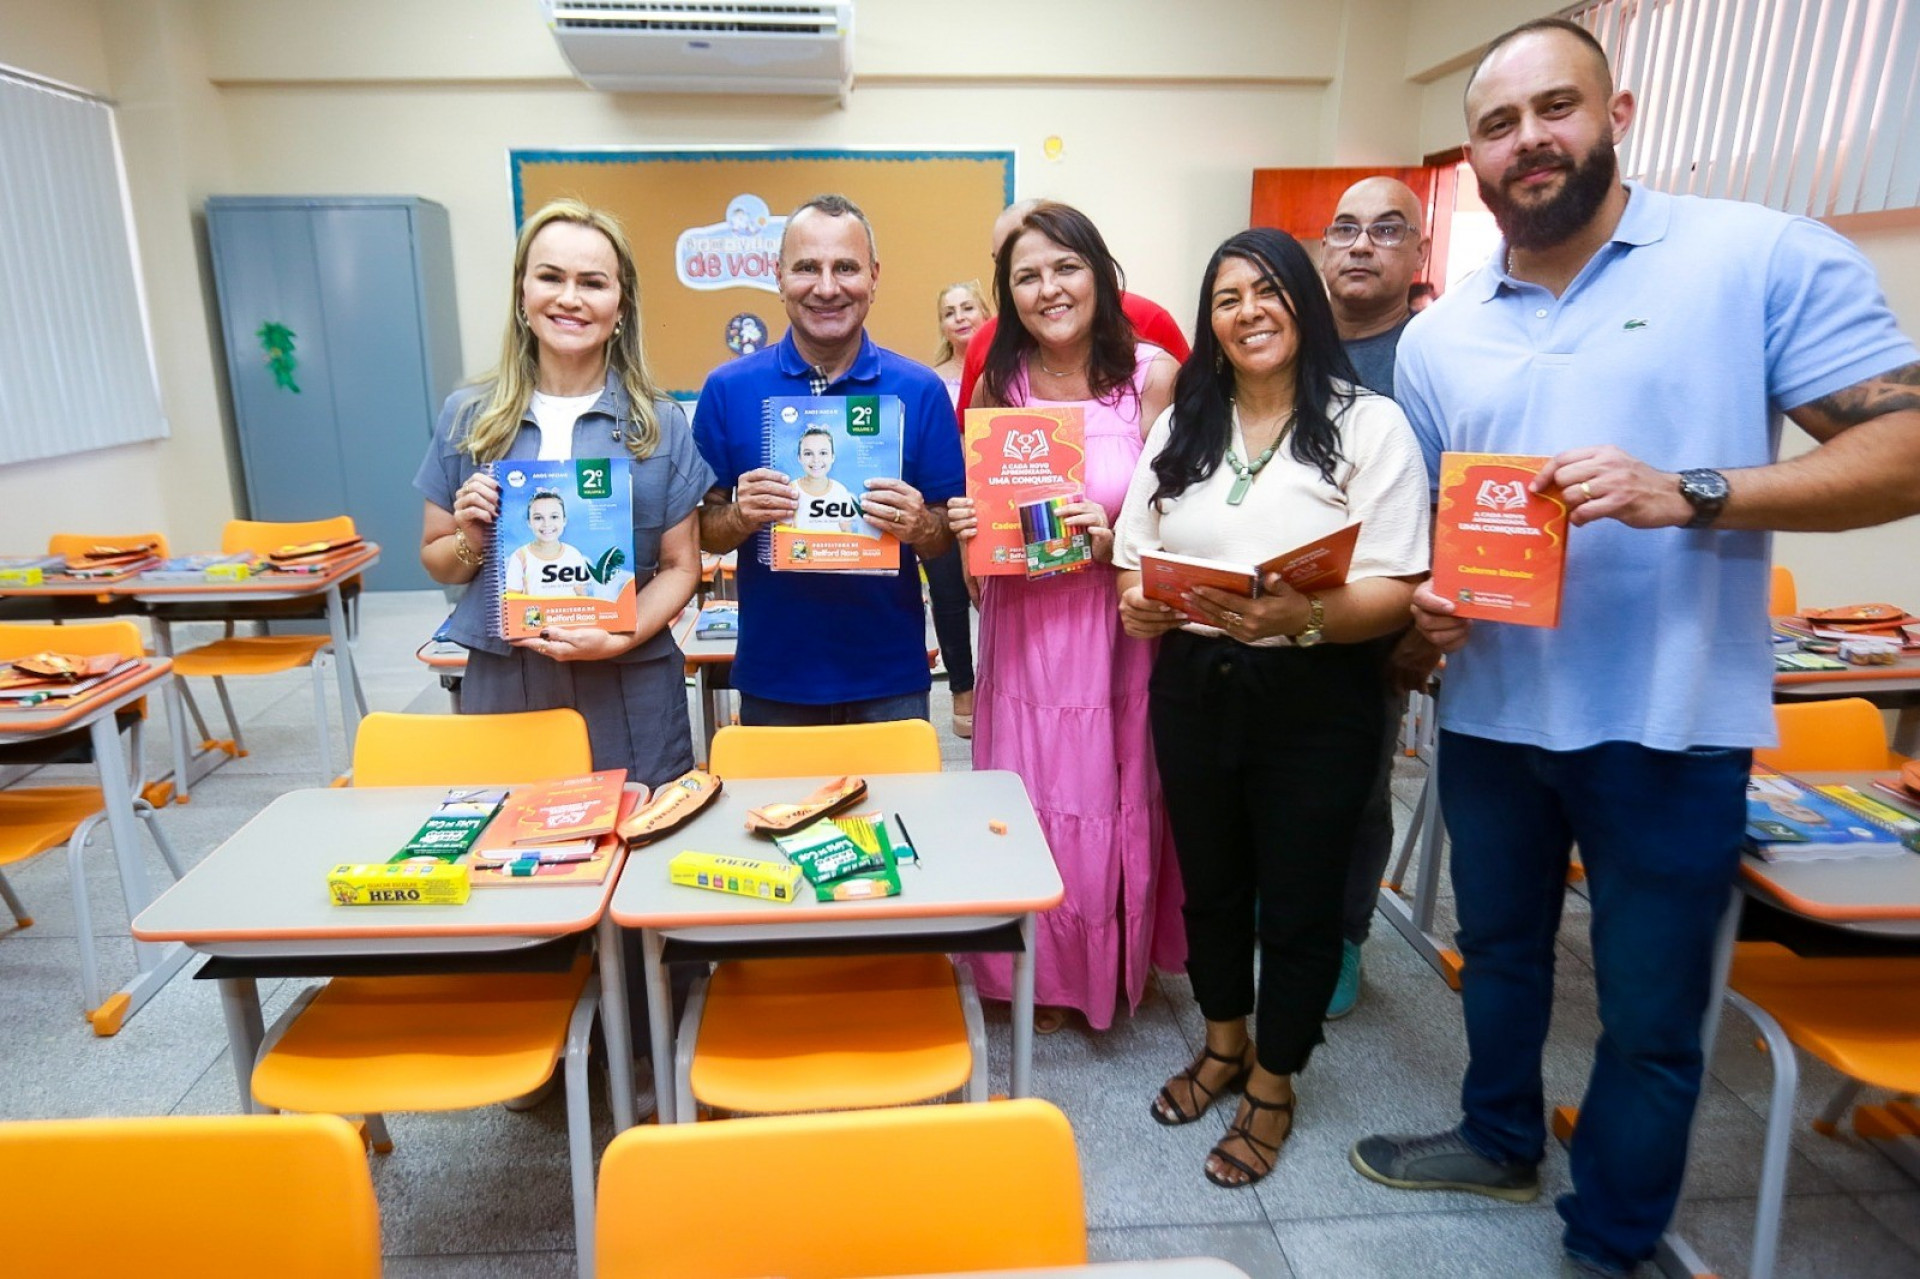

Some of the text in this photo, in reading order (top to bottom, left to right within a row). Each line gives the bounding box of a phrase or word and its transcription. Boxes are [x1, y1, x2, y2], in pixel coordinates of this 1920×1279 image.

[988, 475, 1065, 486] UMA CONQUISTA
[541, 564, 590, 583] Seu
[369, 889, 421, 901] HERO
